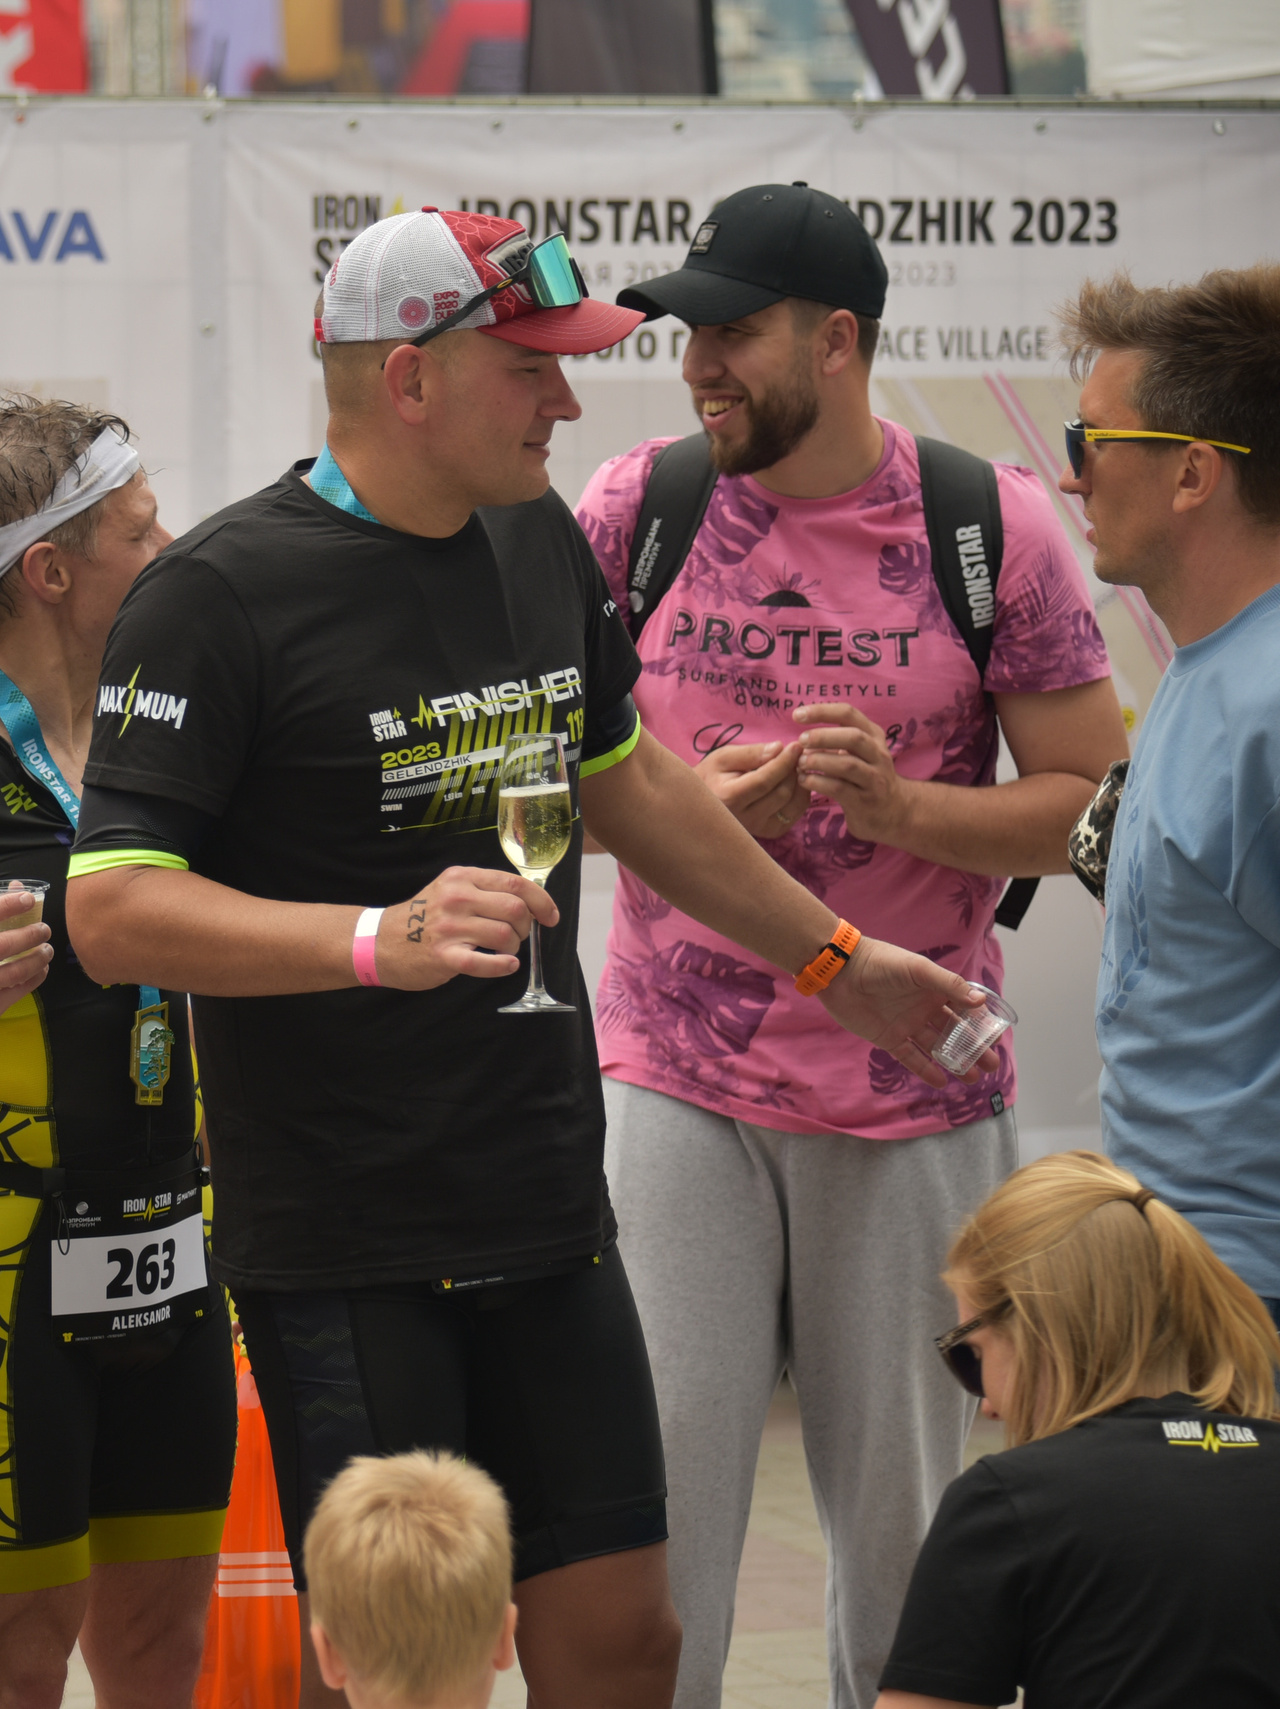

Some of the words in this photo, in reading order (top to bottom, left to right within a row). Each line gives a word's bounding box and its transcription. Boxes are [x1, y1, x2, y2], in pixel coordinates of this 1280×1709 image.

[1011, 199, 1119, 244] 2023
[433, 291, 460, 301] EXPO
[434, 301, 459, 311] 2020
[937, 326, 1051, 361] VILLAGE
[631, 517, 662, 588] ГАЗПРОМБАНК
[955, 523, 995, 629] IRONSTAR
[667, 608, 920, 668] PROTEST
[679, 668, 728, 685] SURF
[734, 676, 778, 692] AND
[785, 682, 897, 697] LIFESTYLE
[430, 667, 583, 727] FINISHER
[369, 710, 393, 727] IRON
[372, 722, 408, 743] STAR
[380, 741, 441, 769] 2023
[384, 755, 472, 782] GELENDZHIK
[21, 738, 72, 804] IRONSTAR
[471, 786, 486, 796] BIKE
[380, 804, 403, 812] SWIM
[123, 1198, 146, 1213] IRON
[154, 1192, 172, 1209] STAR
[106, 1238, 176, 1300] 263
[112, 1305, 171, 1331] ALEKSANDR
[195, 1309, 203, 1318] 113
[1161, 1420, 1203, 1440] IRON
[1217, 1422, 1257, 1443] STAR
